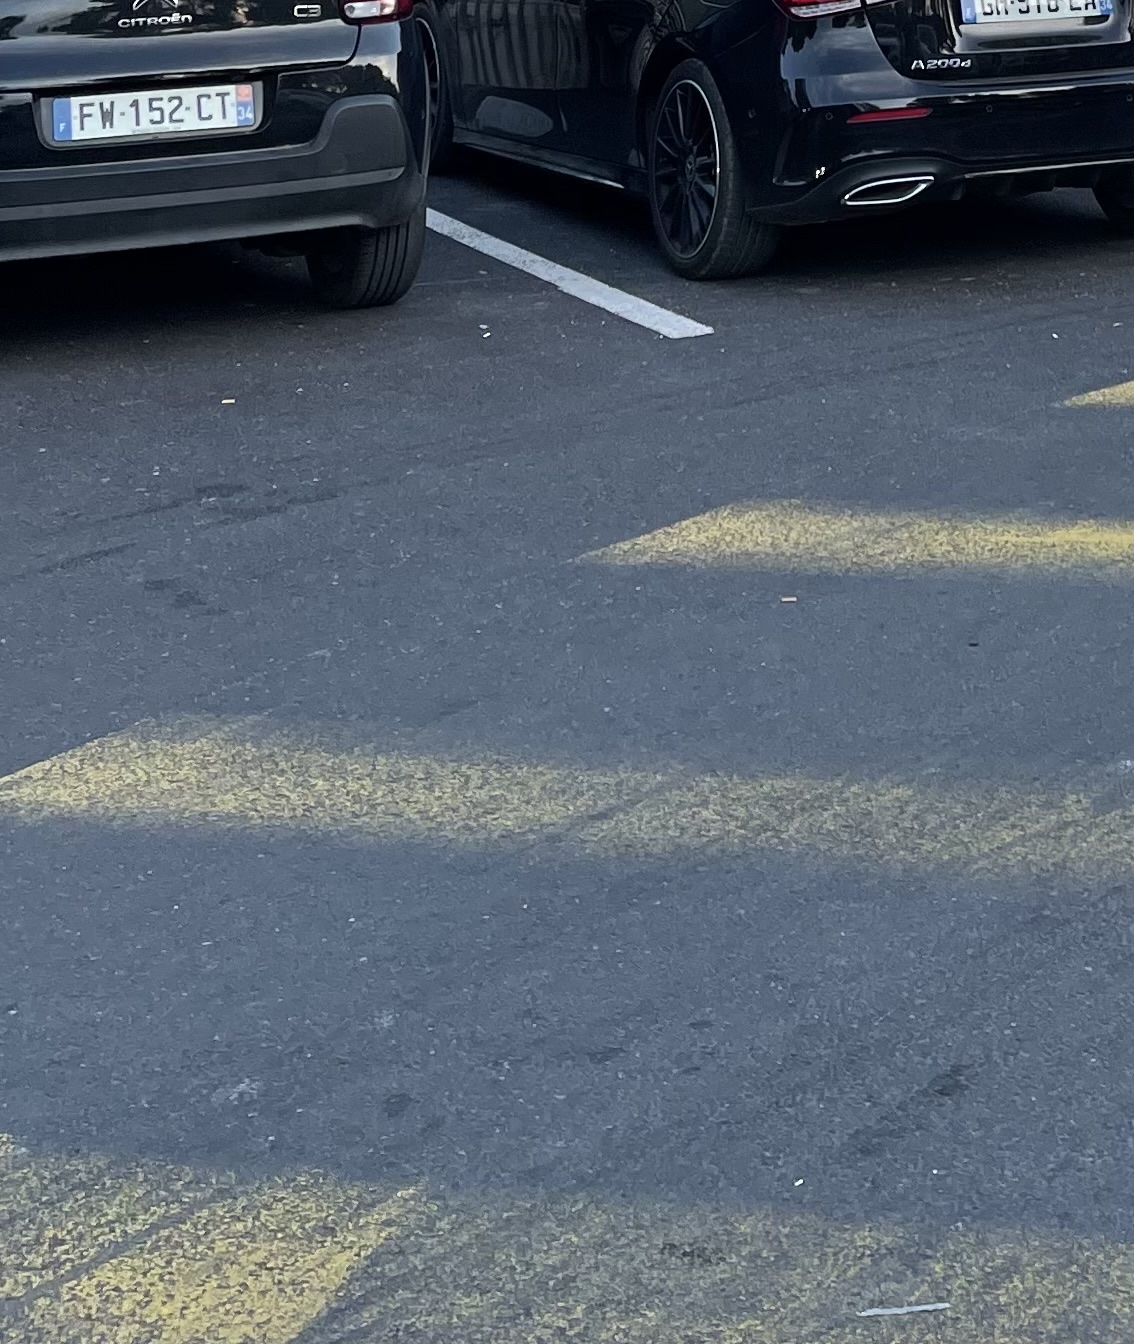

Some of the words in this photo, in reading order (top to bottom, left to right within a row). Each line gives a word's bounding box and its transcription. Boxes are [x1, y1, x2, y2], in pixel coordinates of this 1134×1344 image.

[293, 4, 322, 18] C3
[78, 92, 231, 132] FW-152-CT
[238, 106, 253, 120] 34
